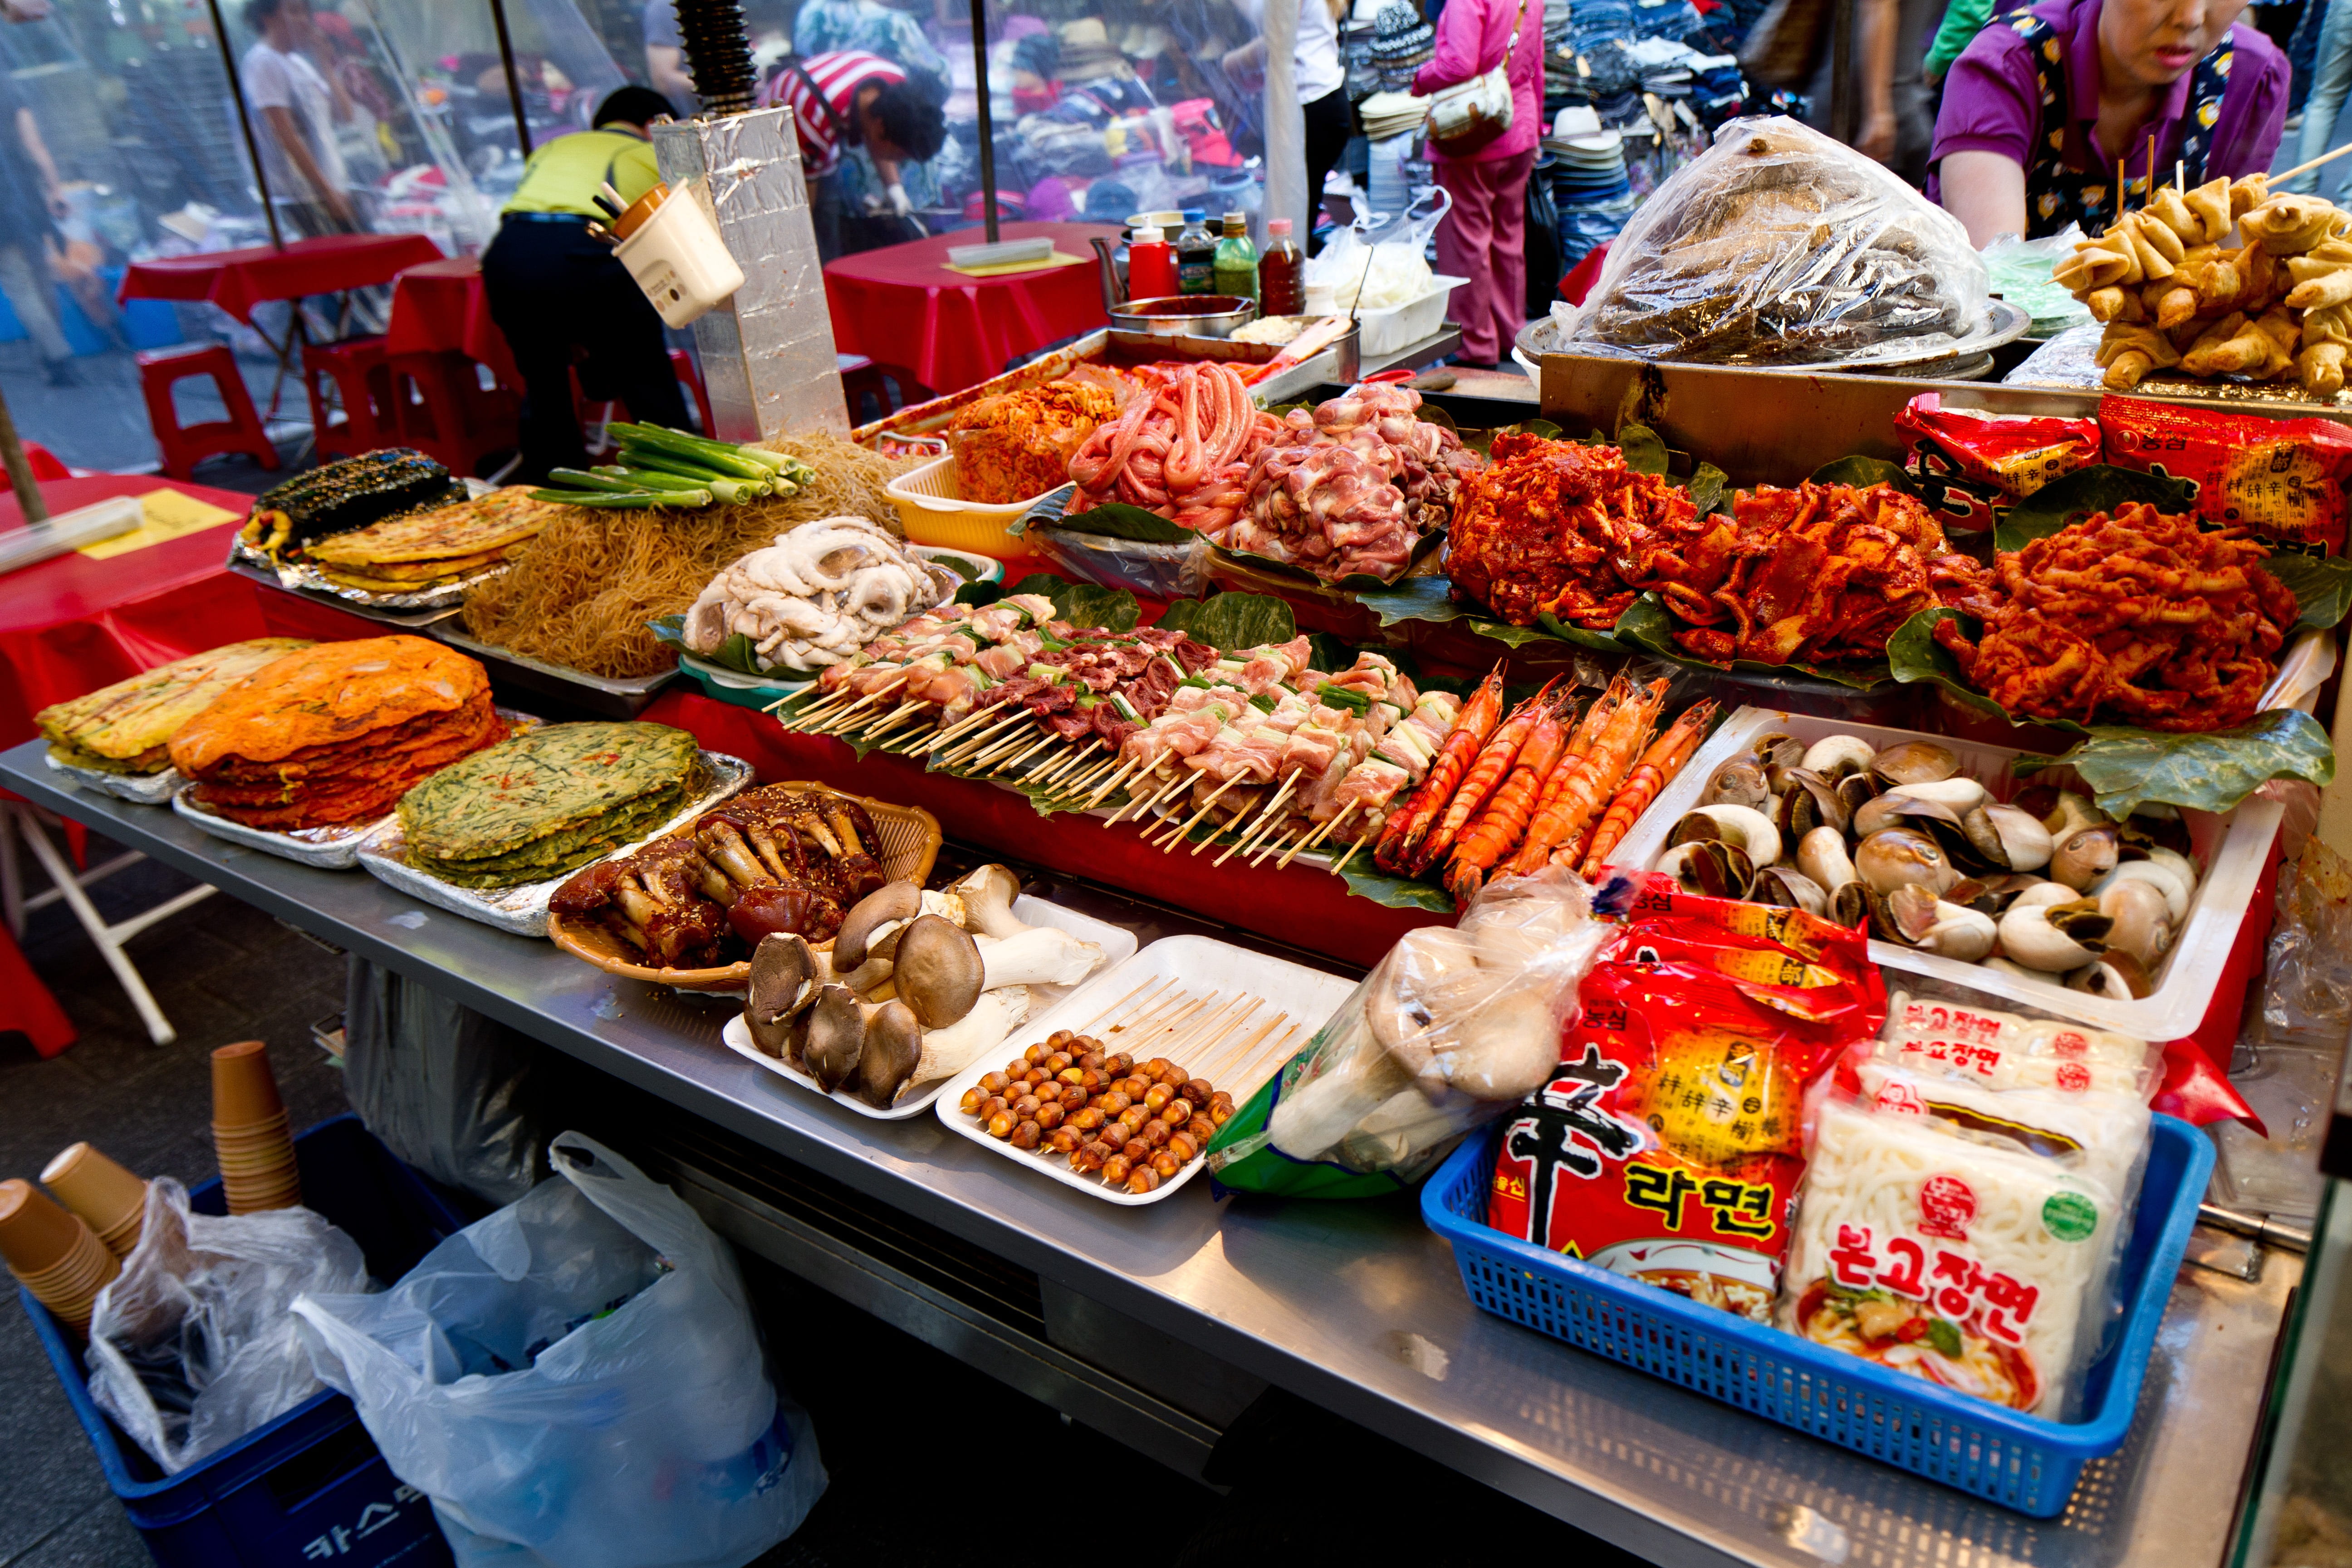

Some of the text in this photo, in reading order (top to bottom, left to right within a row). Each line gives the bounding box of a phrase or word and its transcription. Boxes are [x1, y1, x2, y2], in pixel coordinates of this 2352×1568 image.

[1583, 1008, 1627, 1031] 농심
[1623, 1161, 1776, 1242] 라면
[1828, 1223, 2039, 1344] 본고장면
